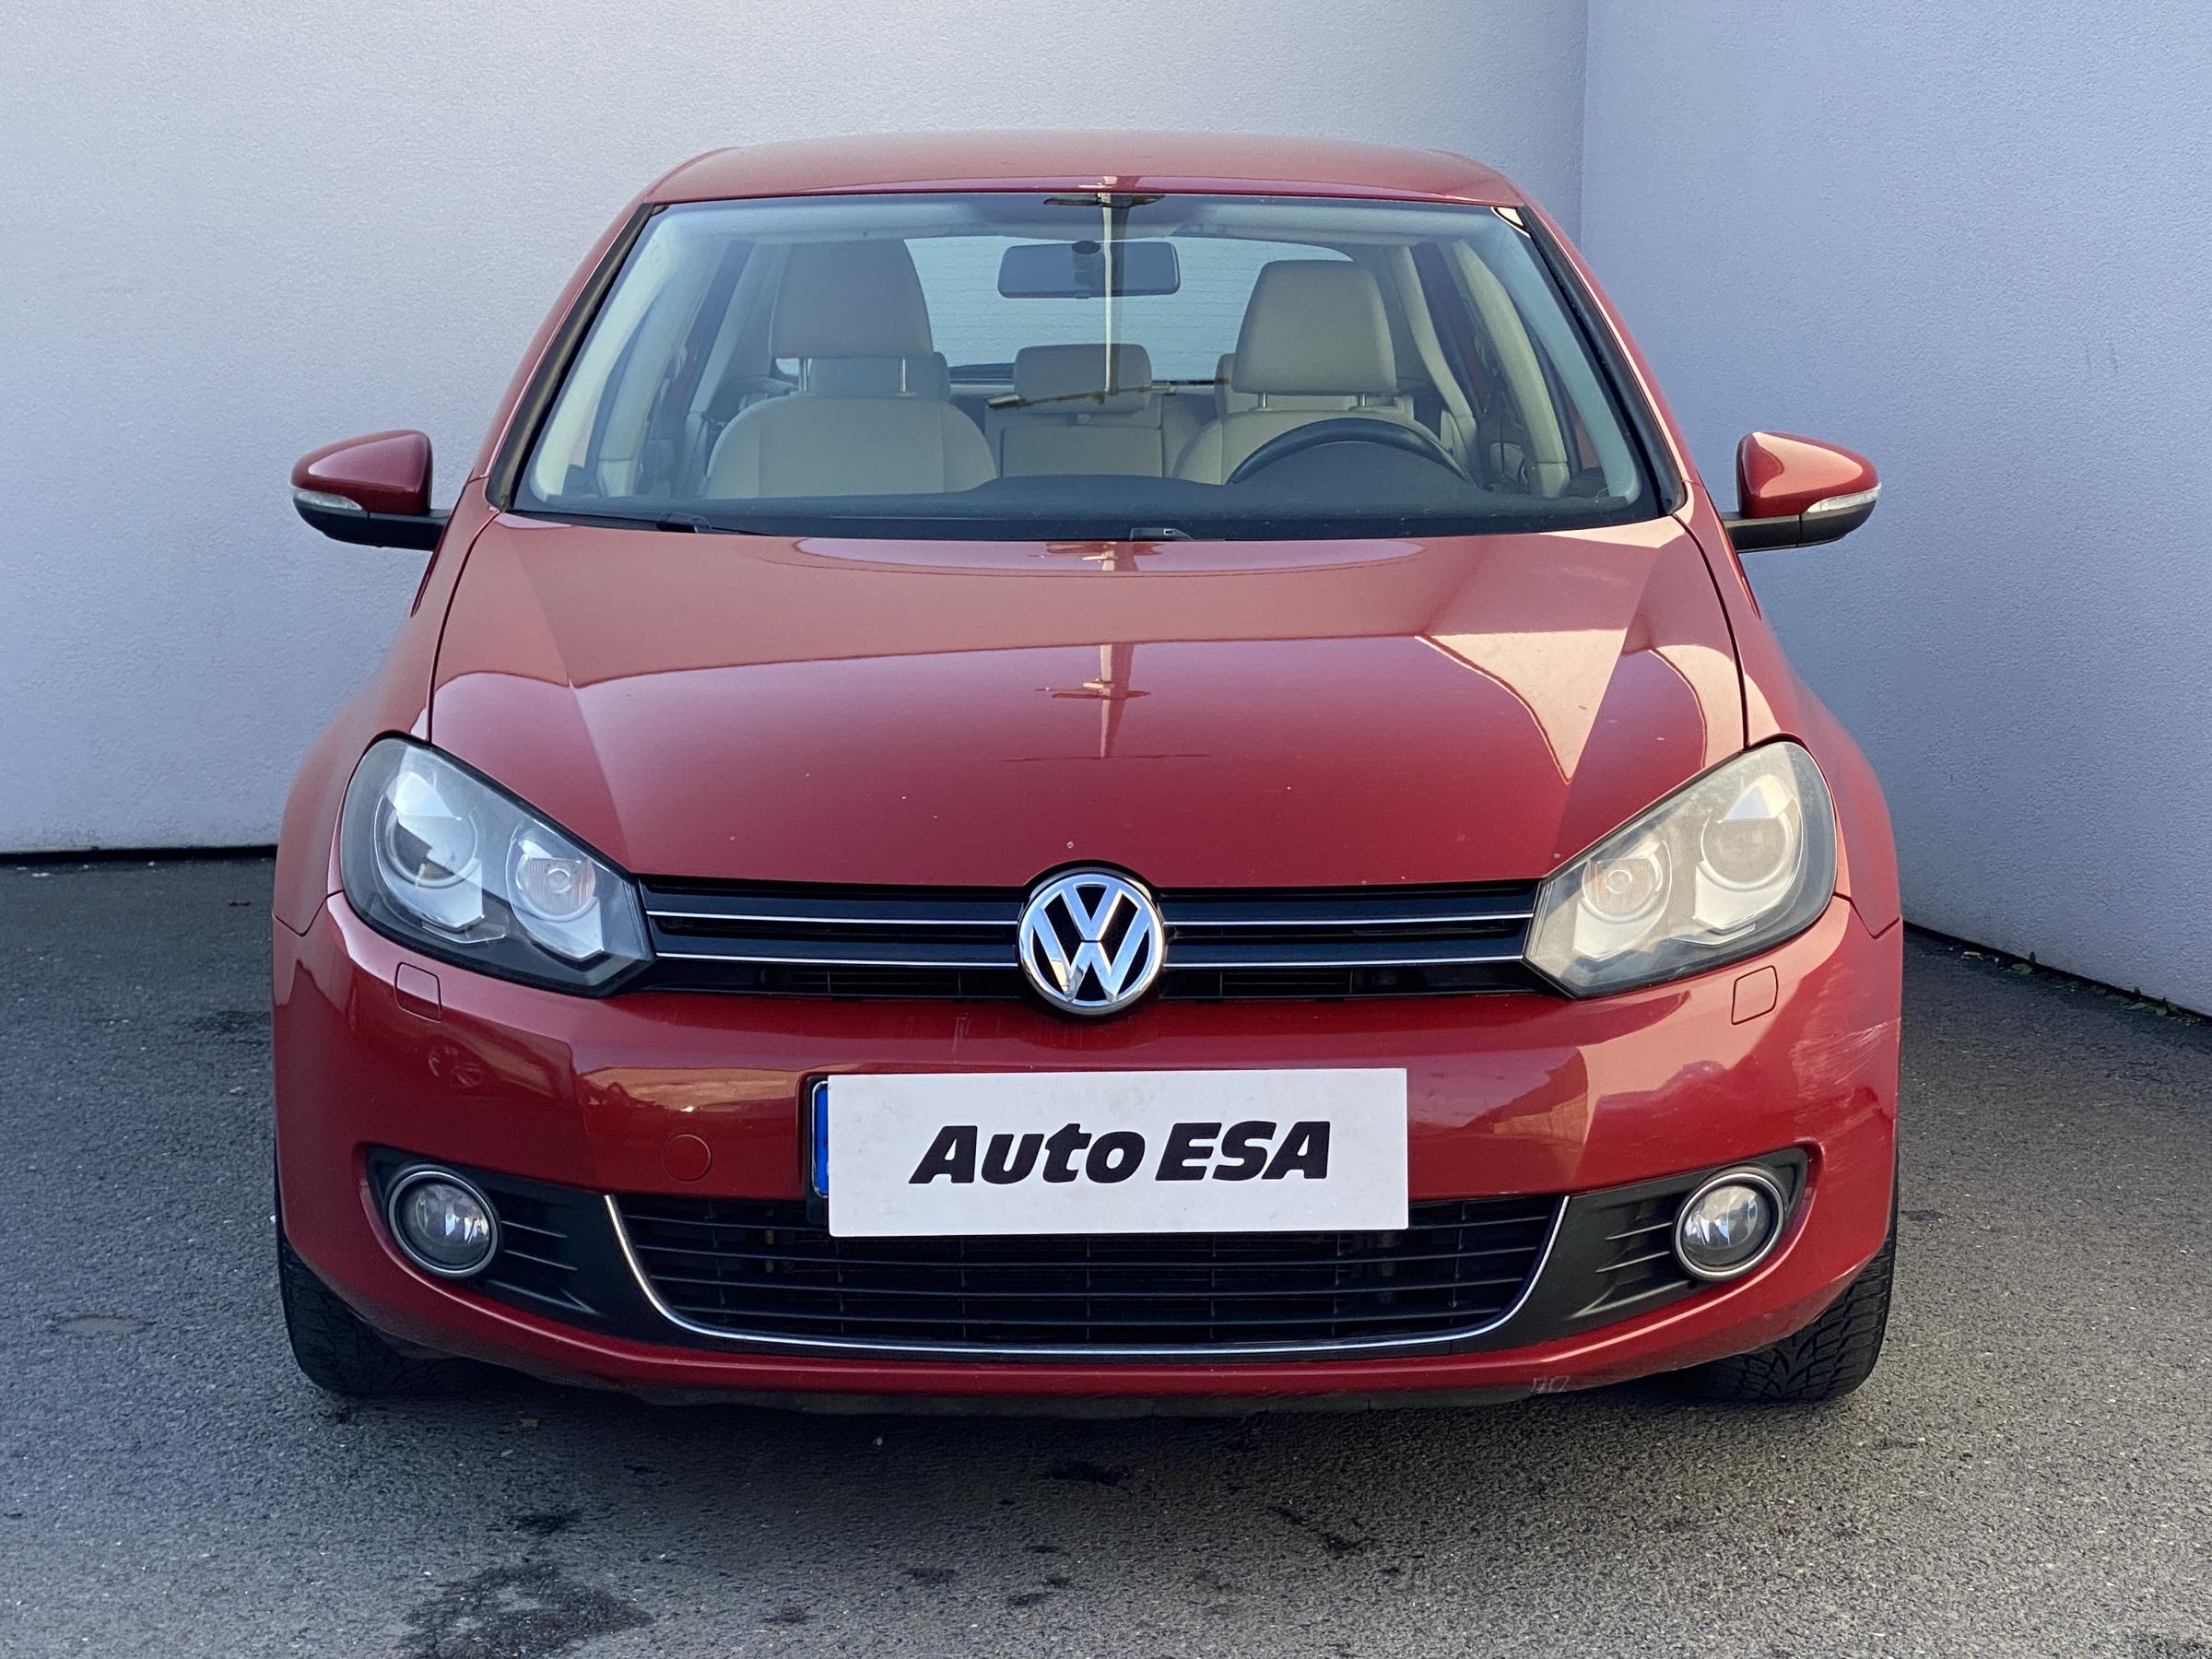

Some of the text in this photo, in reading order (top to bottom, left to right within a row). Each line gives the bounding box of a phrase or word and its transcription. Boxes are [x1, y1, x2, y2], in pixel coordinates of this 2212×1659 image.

[1025, 877, 1159, 1007] VW
[908, 1120, 1331, 1185] Auto ESA
